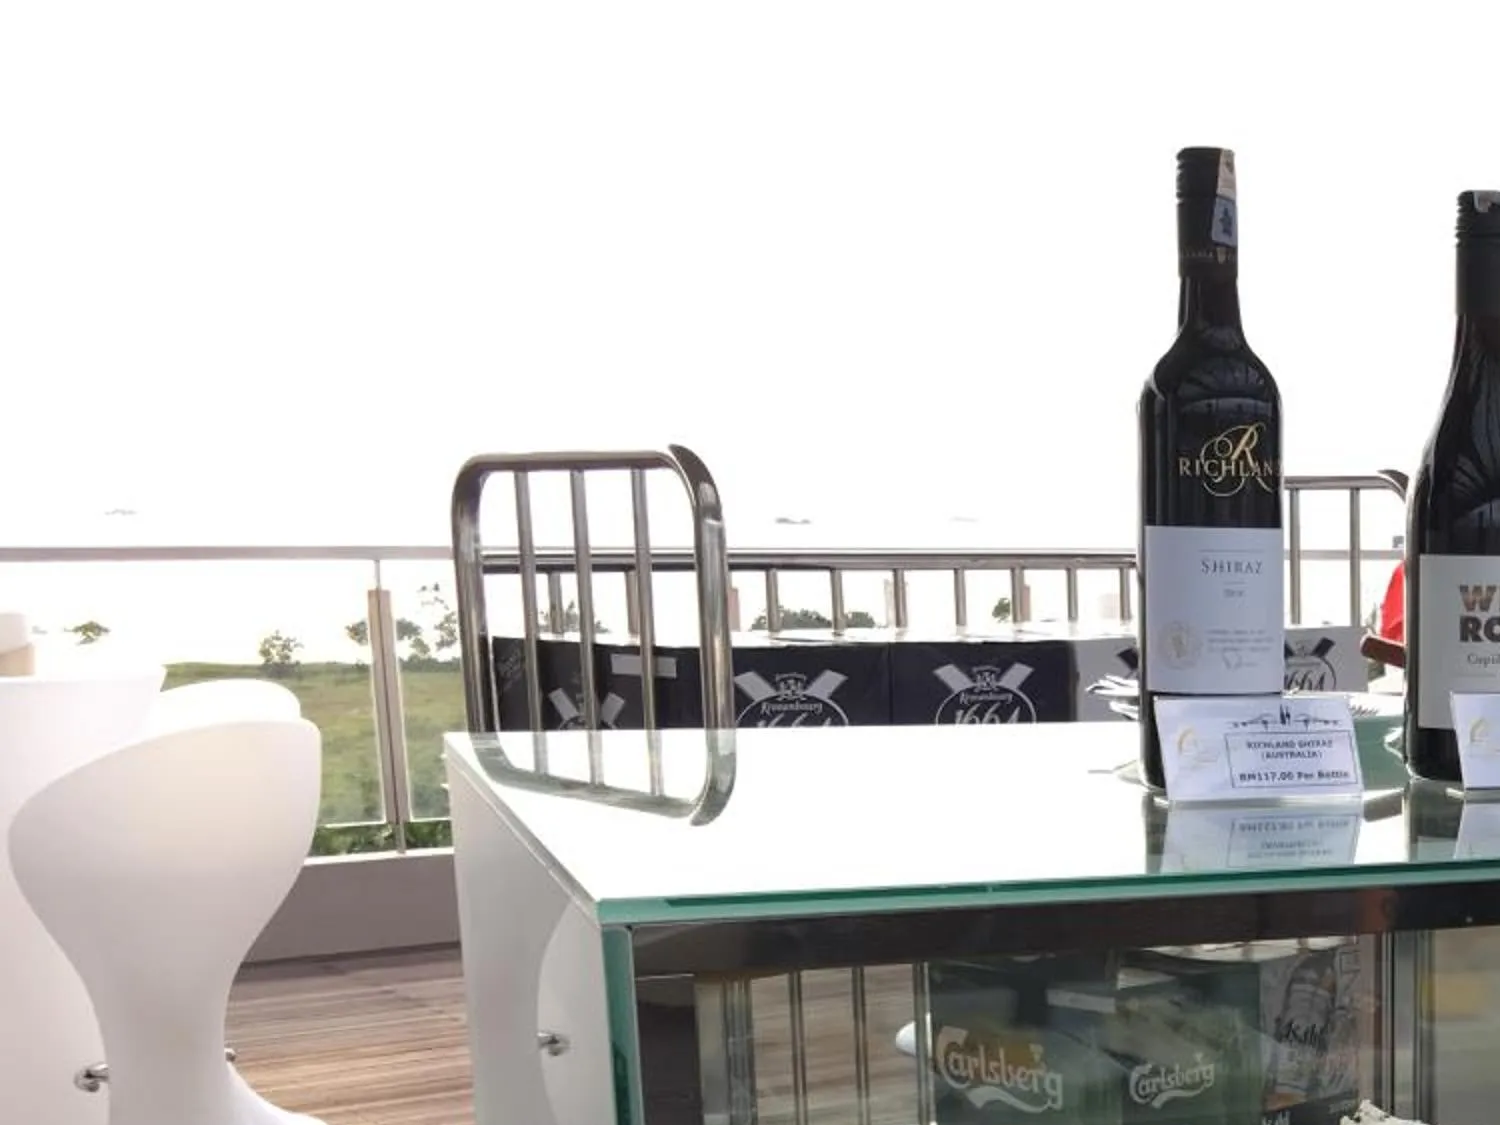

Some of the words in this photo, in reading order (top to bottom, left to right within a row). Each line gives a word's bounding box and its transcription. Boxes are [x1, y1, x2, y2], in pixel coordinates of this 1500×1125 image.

[1178, 457, 1282, 477] RICHLAN
[1200, 559, 1263, 575] SHIRAZ
[935, 1025, 1064, 1110] Carlsberg
[1128, 1058, 1216, 1106] Carlsberg
